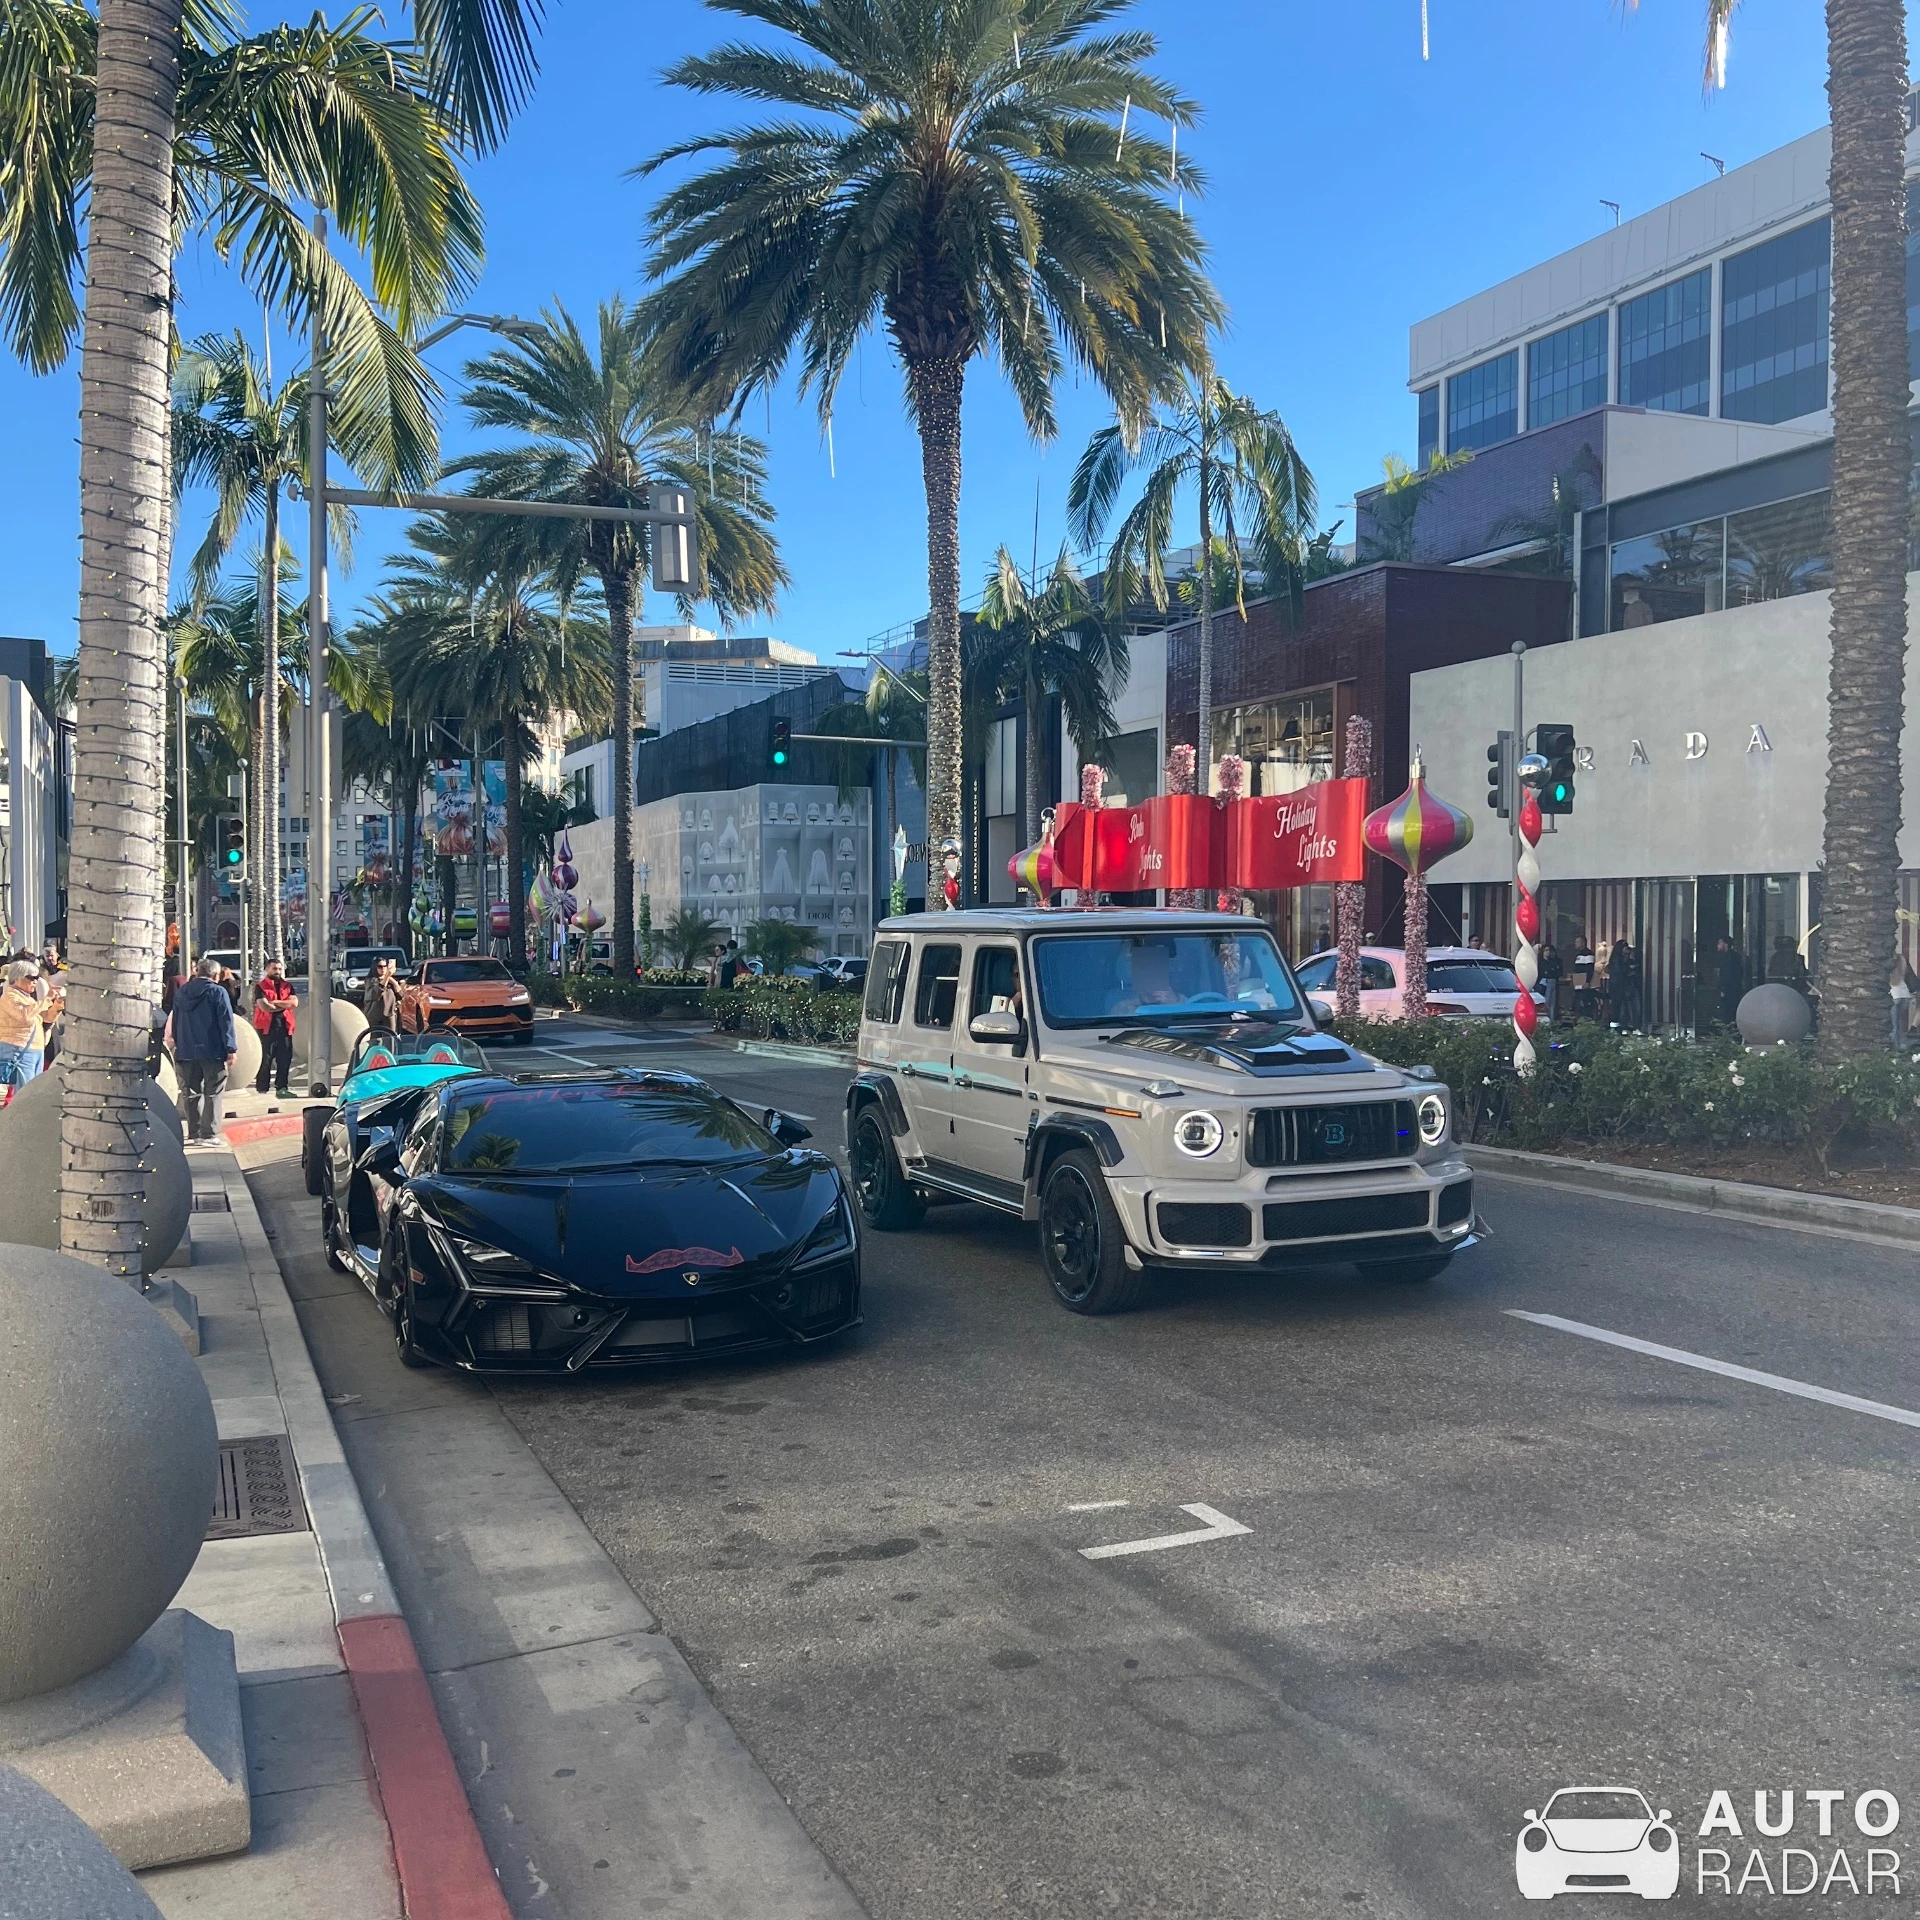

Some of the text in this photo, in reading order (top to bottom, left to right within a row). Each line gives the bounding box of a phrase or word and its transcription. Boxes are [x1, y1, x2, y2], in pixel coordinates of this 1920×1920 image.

[1575, 723, 1774, 772] RADA
[1273, 799, 1317, 838] Holiday
[1296, 832, 1337, 873] Lights
[807, 912, 831, 920] DIOR
[1324, 1123, 1345, 1145] B
